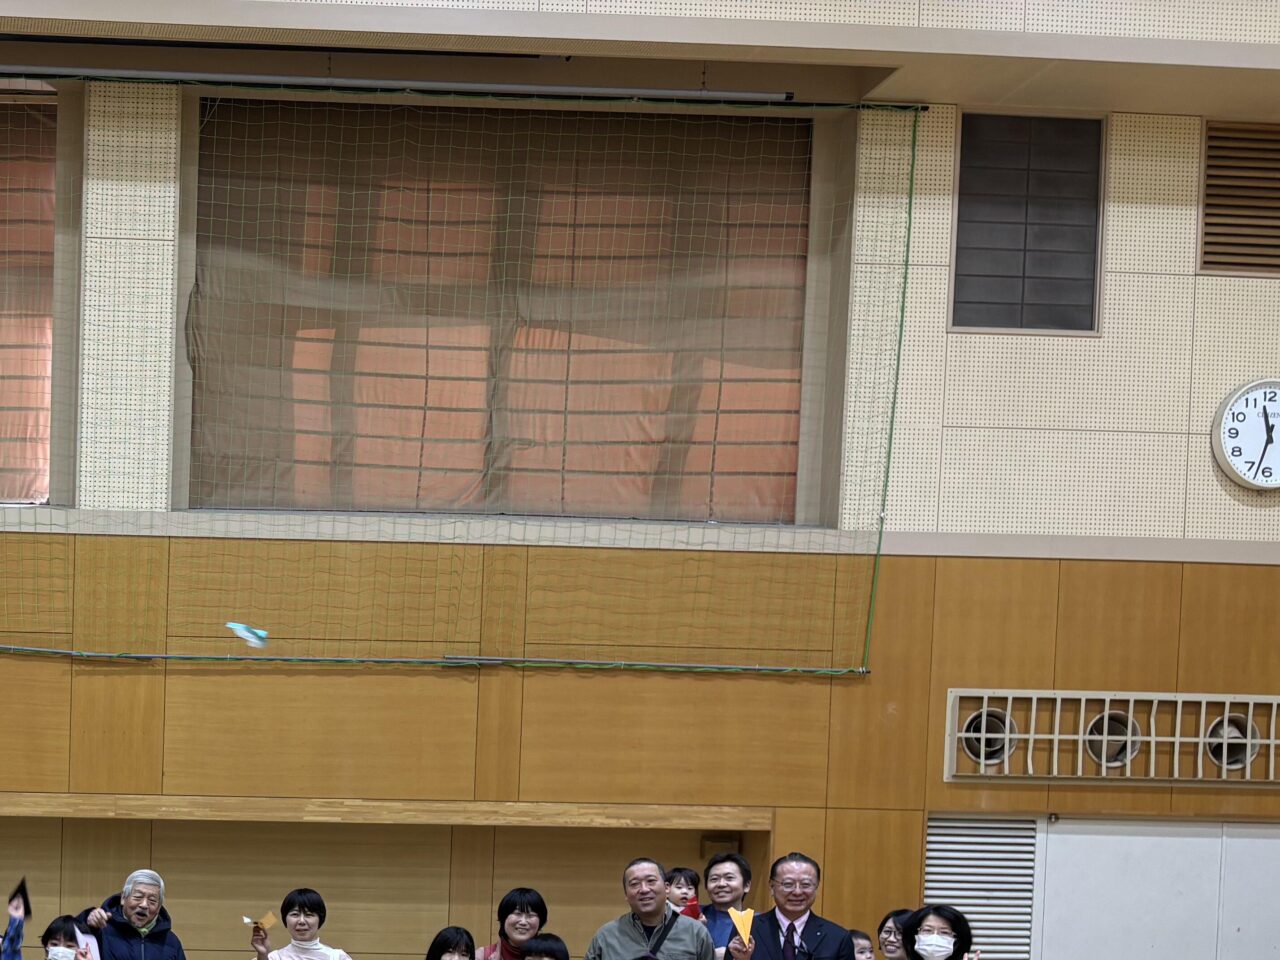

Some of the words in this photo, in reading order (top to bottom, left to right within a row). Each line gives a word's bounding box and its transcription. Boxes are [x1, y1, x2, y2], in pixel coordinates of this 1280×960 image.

[1263, 391, 1277, 402] 12
[1245, 397, 1257, 408] 11
[1231, 411, 1246, 422] 10
[1228, 427, 1239, 438] 9
[1231, 446, 1242, 457] 8
[1244, 461, 1255, 472] 7
[1261, 467, 1272, 478] 6
